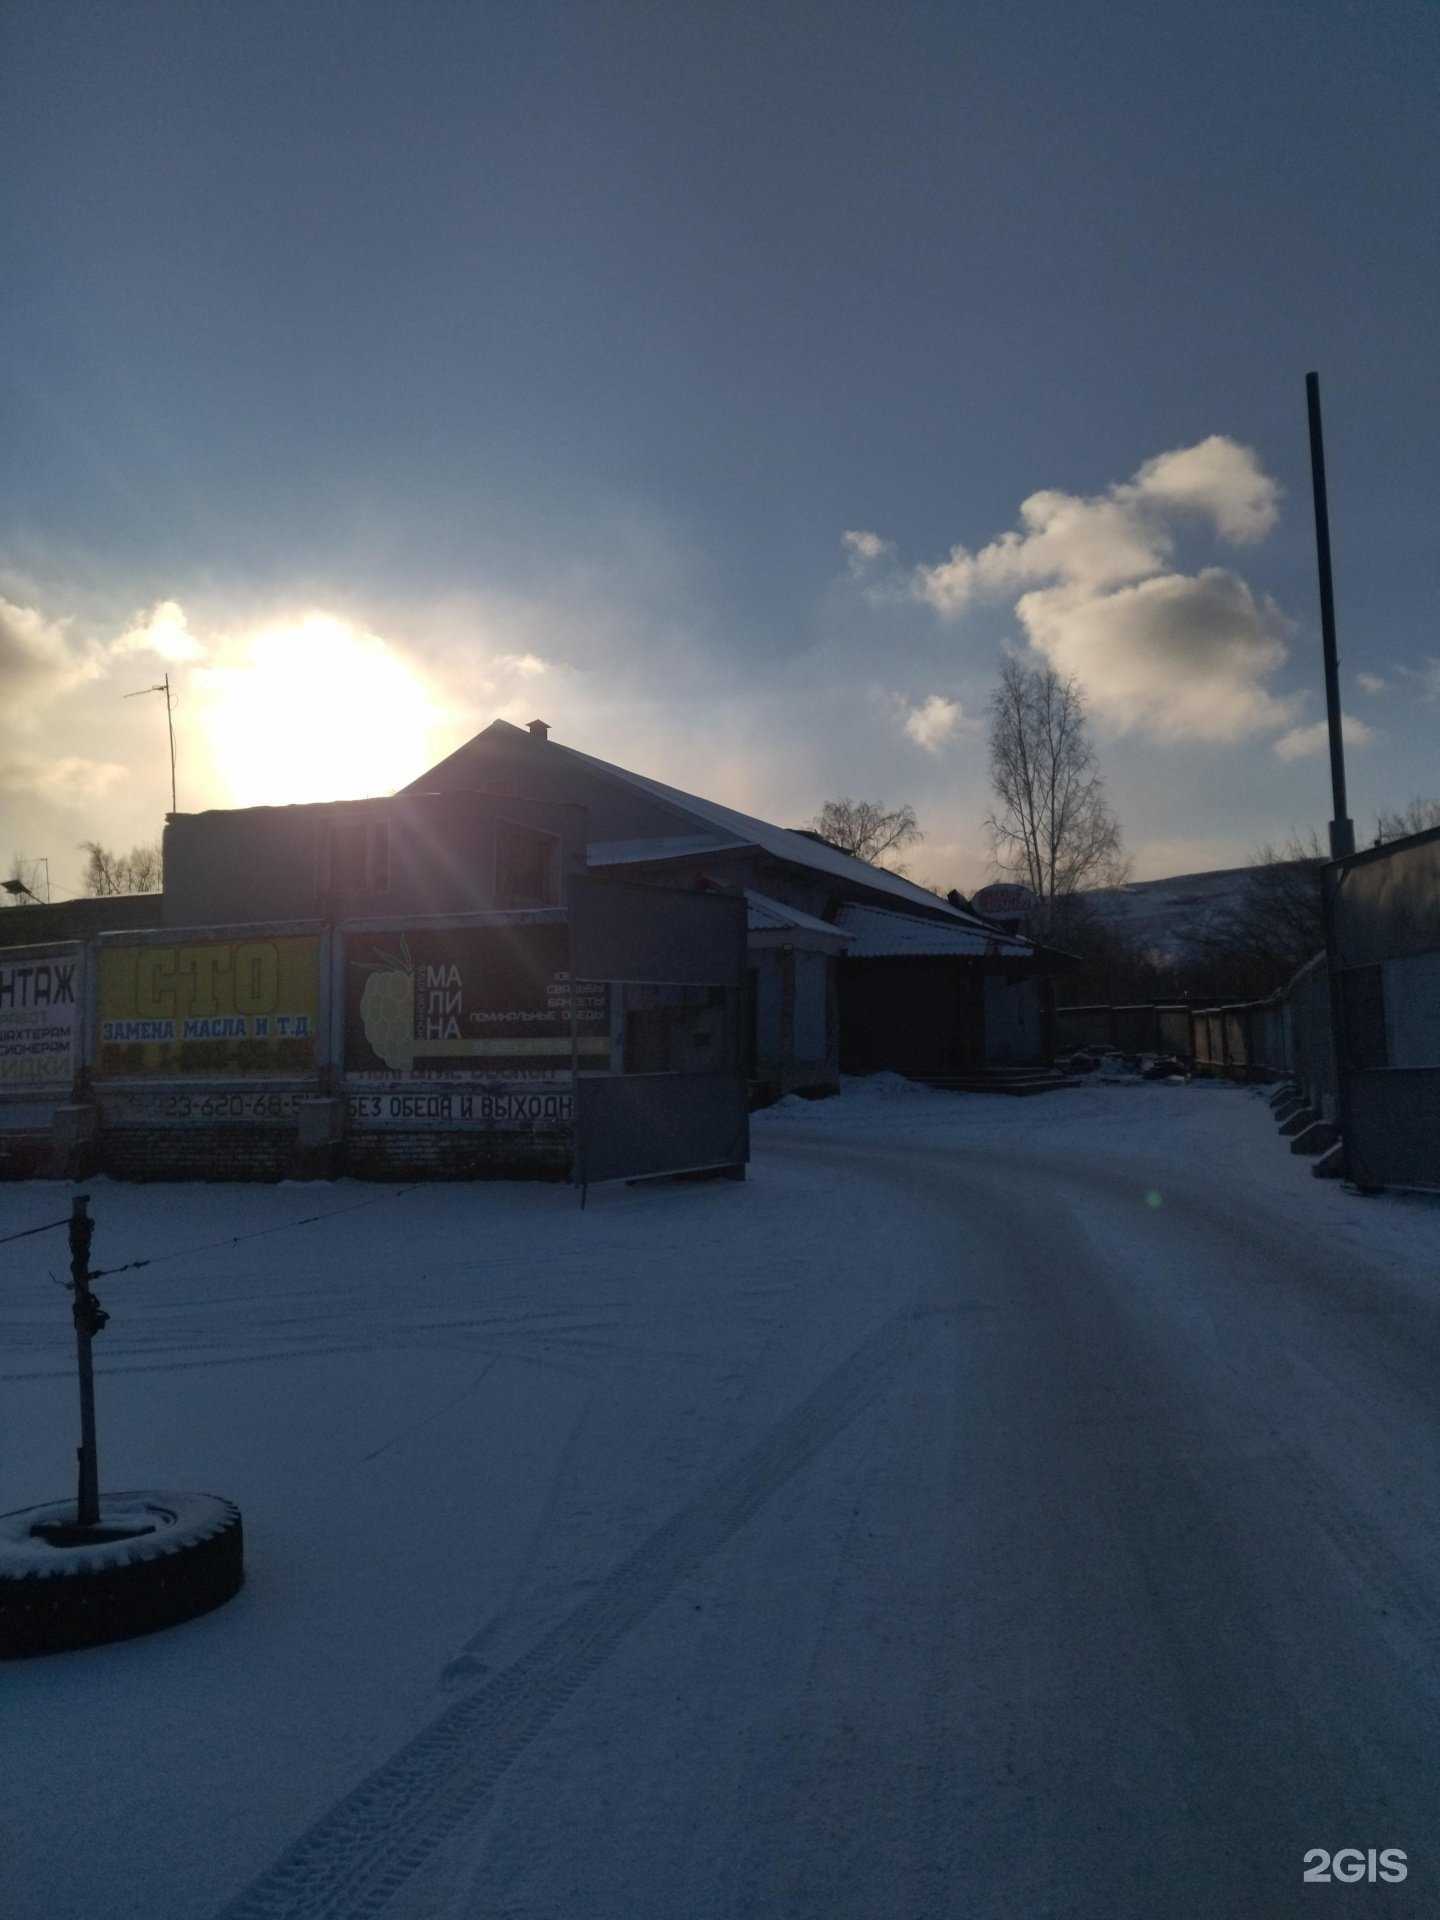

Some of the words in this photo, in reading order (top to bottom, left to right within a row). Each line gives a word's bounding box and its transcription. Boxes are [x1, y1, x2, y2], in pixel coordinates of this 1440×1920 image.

[0, 964, 75, 1008] НТАЖ
[134, 943, 280, 1018] СТО
[427, 963, 463, 988] МА
[428, 990, 463, 1015] ЛИ
[103, 1021, 175, 1040] ЗАМЕНА
[184, 1019, 247, 1039] МАСЛА
[255, 1018, 269, 1038] И
[427, 1015, 463, 1040] НА
[347, 1096, 382, 1118] БЕЗ
[389, 1096, 452, 1118] ОБЕДА
[460, 1096, 473, 1118] И
